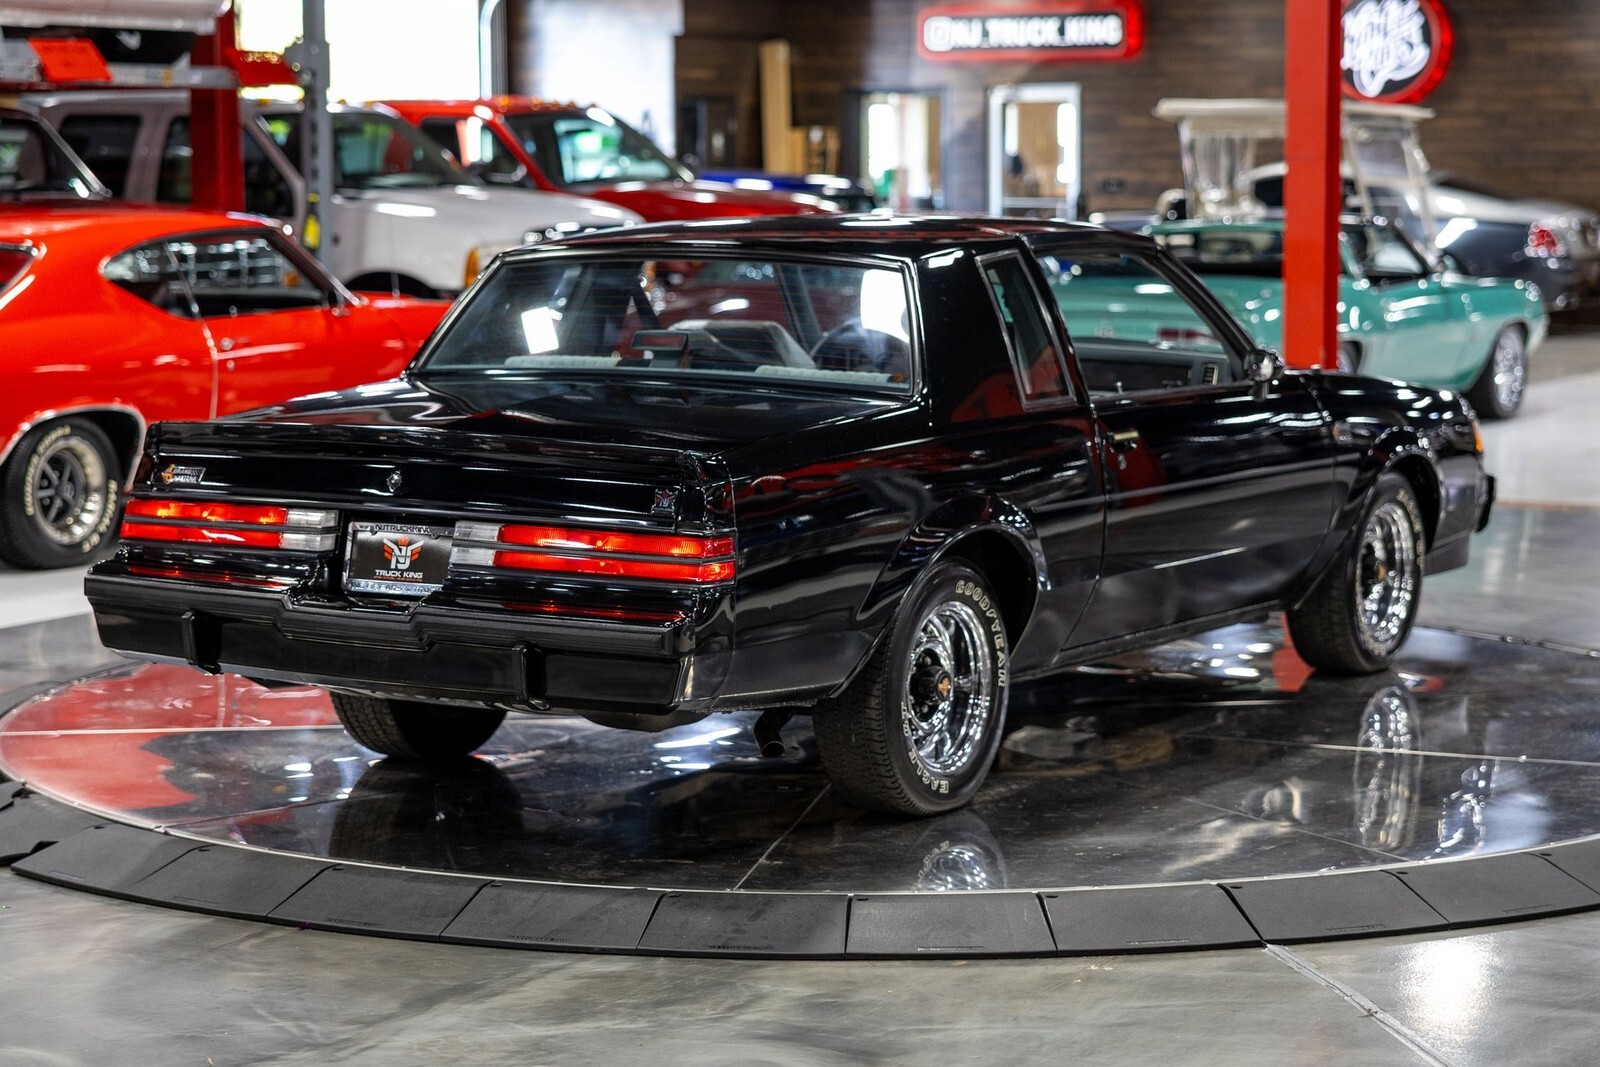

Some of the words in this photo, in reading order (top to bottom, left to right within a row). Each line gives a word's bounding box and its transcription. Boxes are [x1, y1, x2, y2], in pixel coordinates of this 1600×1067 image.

[375, 569, 402, 577] TRUCK
[403, 571, 424, 579] KING
[955, 579, 1007, 687] GOODYEAR
[908, 748, 949, 794] EAGLE
